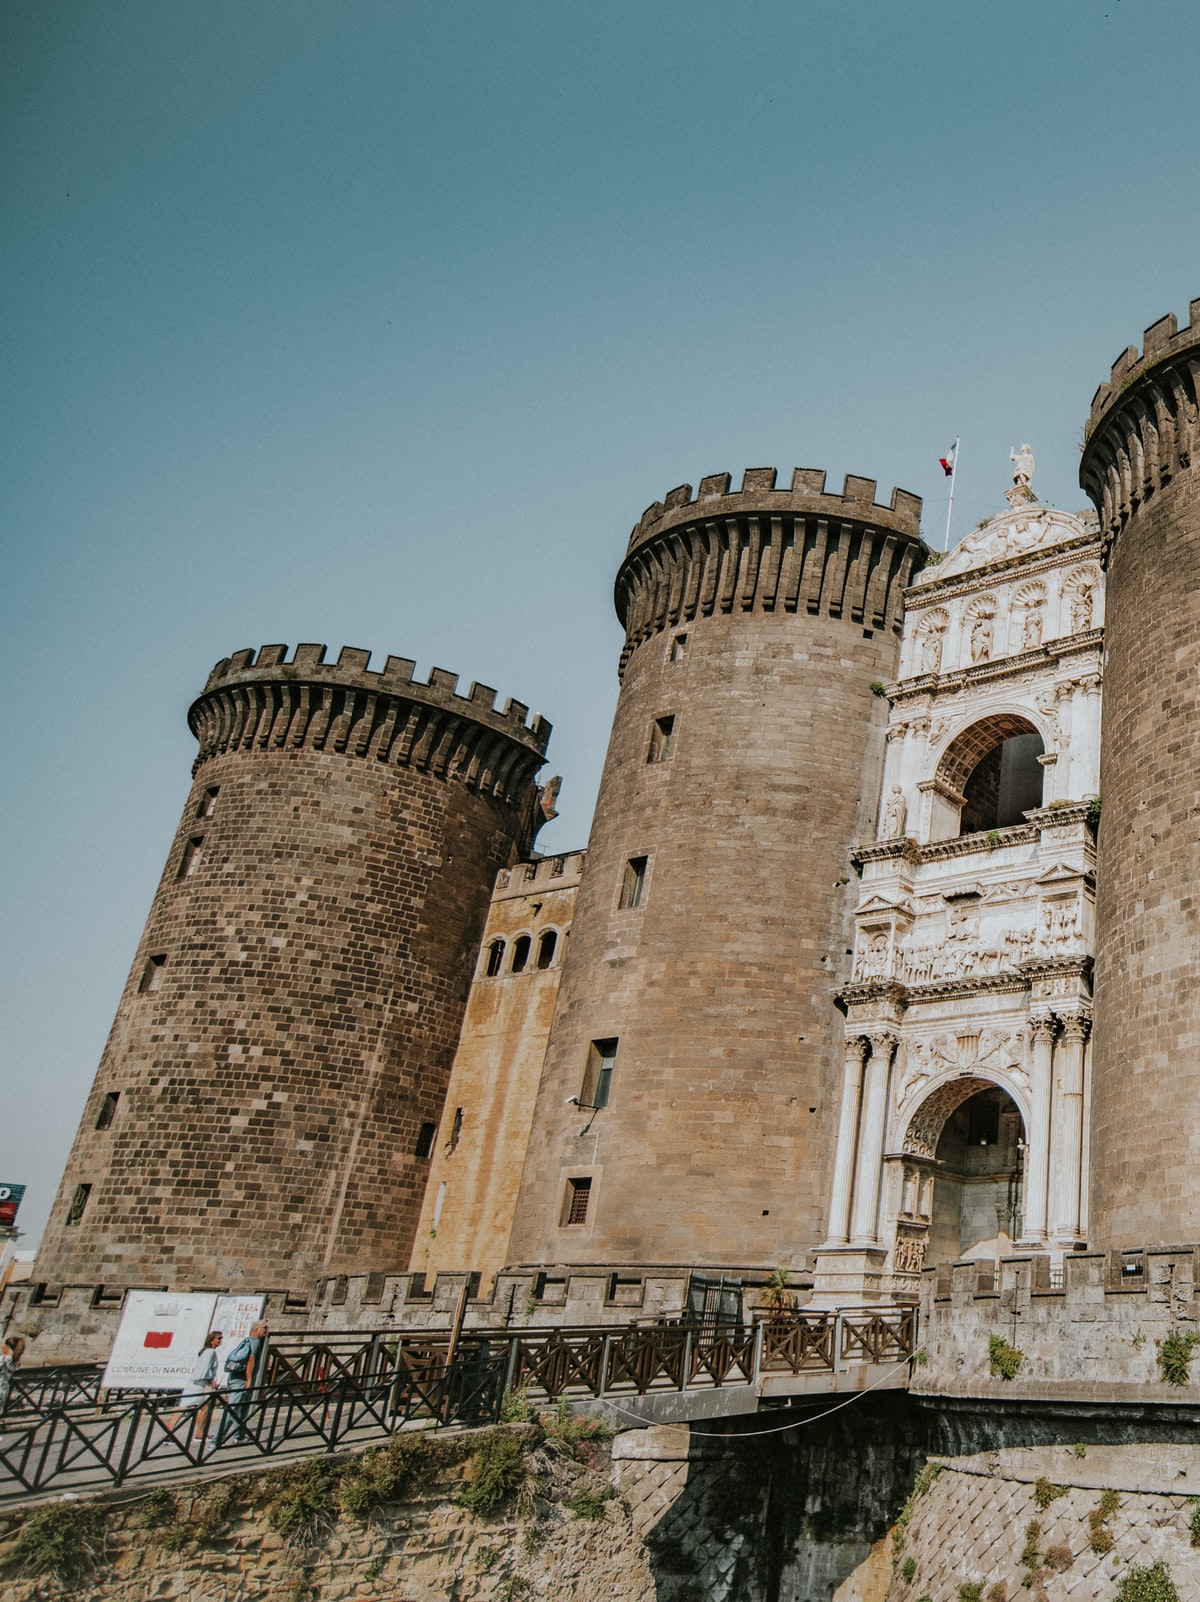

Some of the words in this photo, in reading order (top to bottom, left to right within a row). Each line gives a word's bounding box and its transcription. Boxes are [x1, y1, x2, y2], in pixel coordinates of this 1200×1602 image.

[111, 1365, 149, 1374] COMUNE
[151, 1366, 161, 1374] DI
[162, 1366, 195, 1375] NAPOLI
